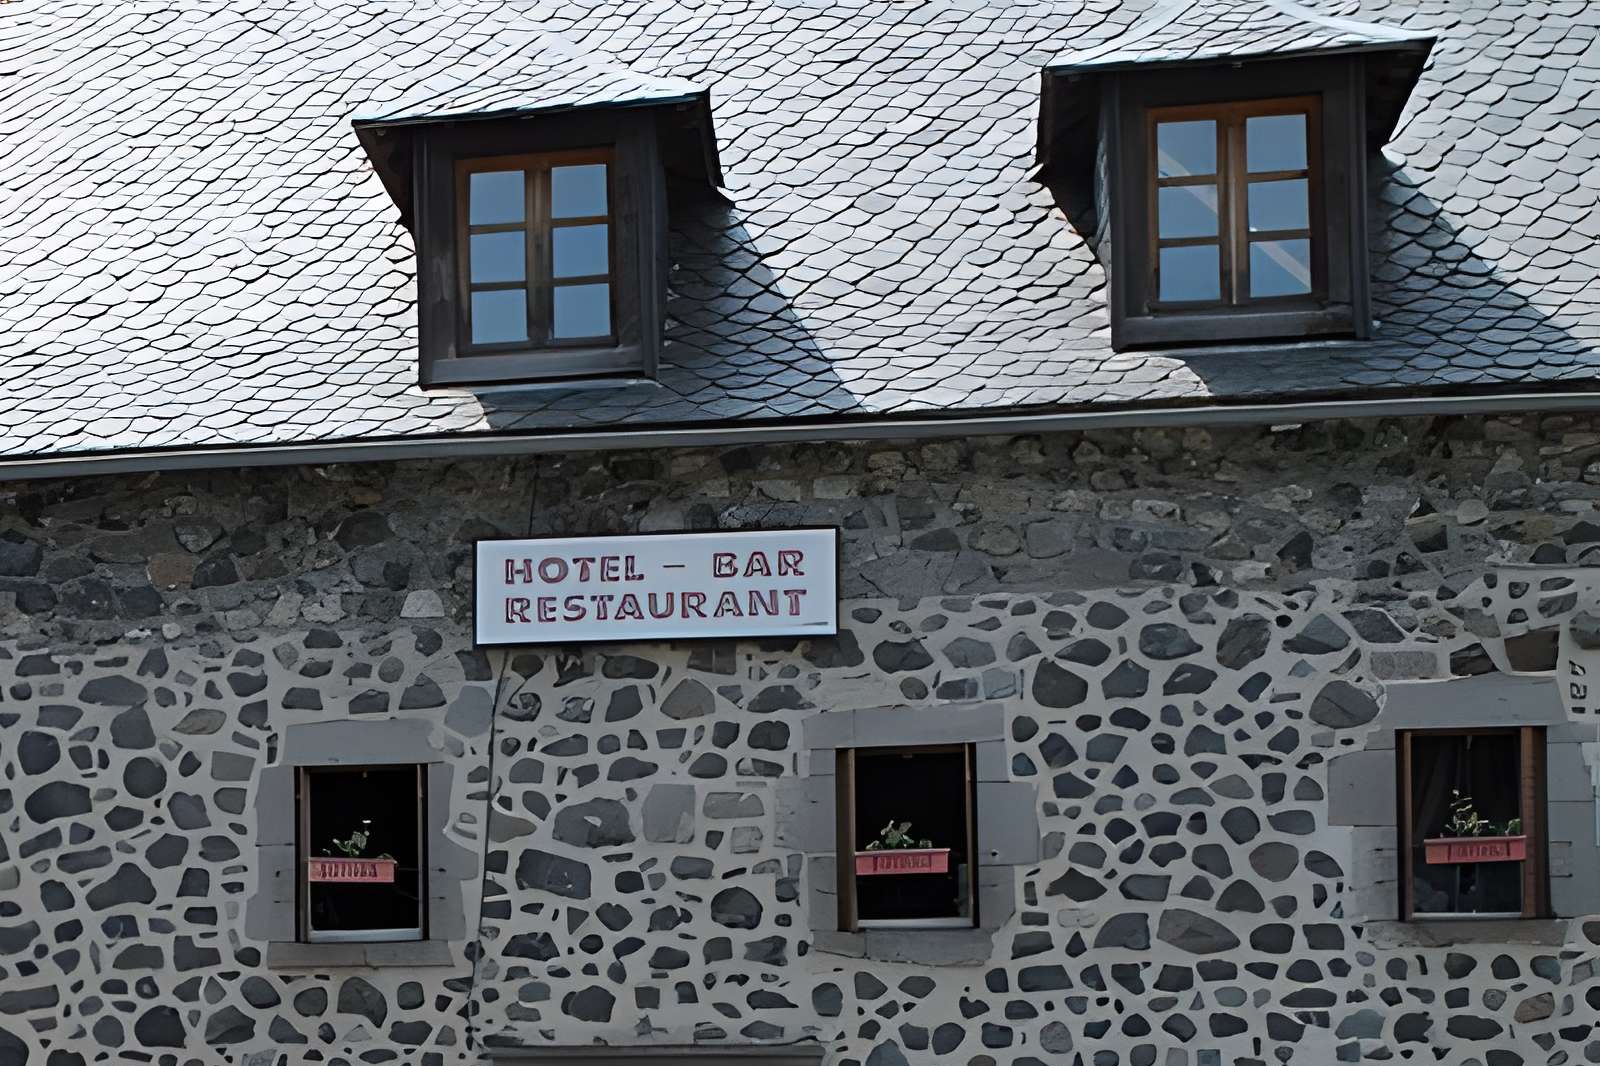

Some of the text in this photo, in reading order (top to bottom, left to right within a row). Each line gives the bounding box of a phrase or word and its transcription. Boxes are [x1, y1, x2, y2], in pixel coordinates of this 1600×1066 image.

[504, 555, 645, 585] HOTEL
[712, 550, 806, 579] BAR
[504, 588, 808, 625] RESTAURANT
